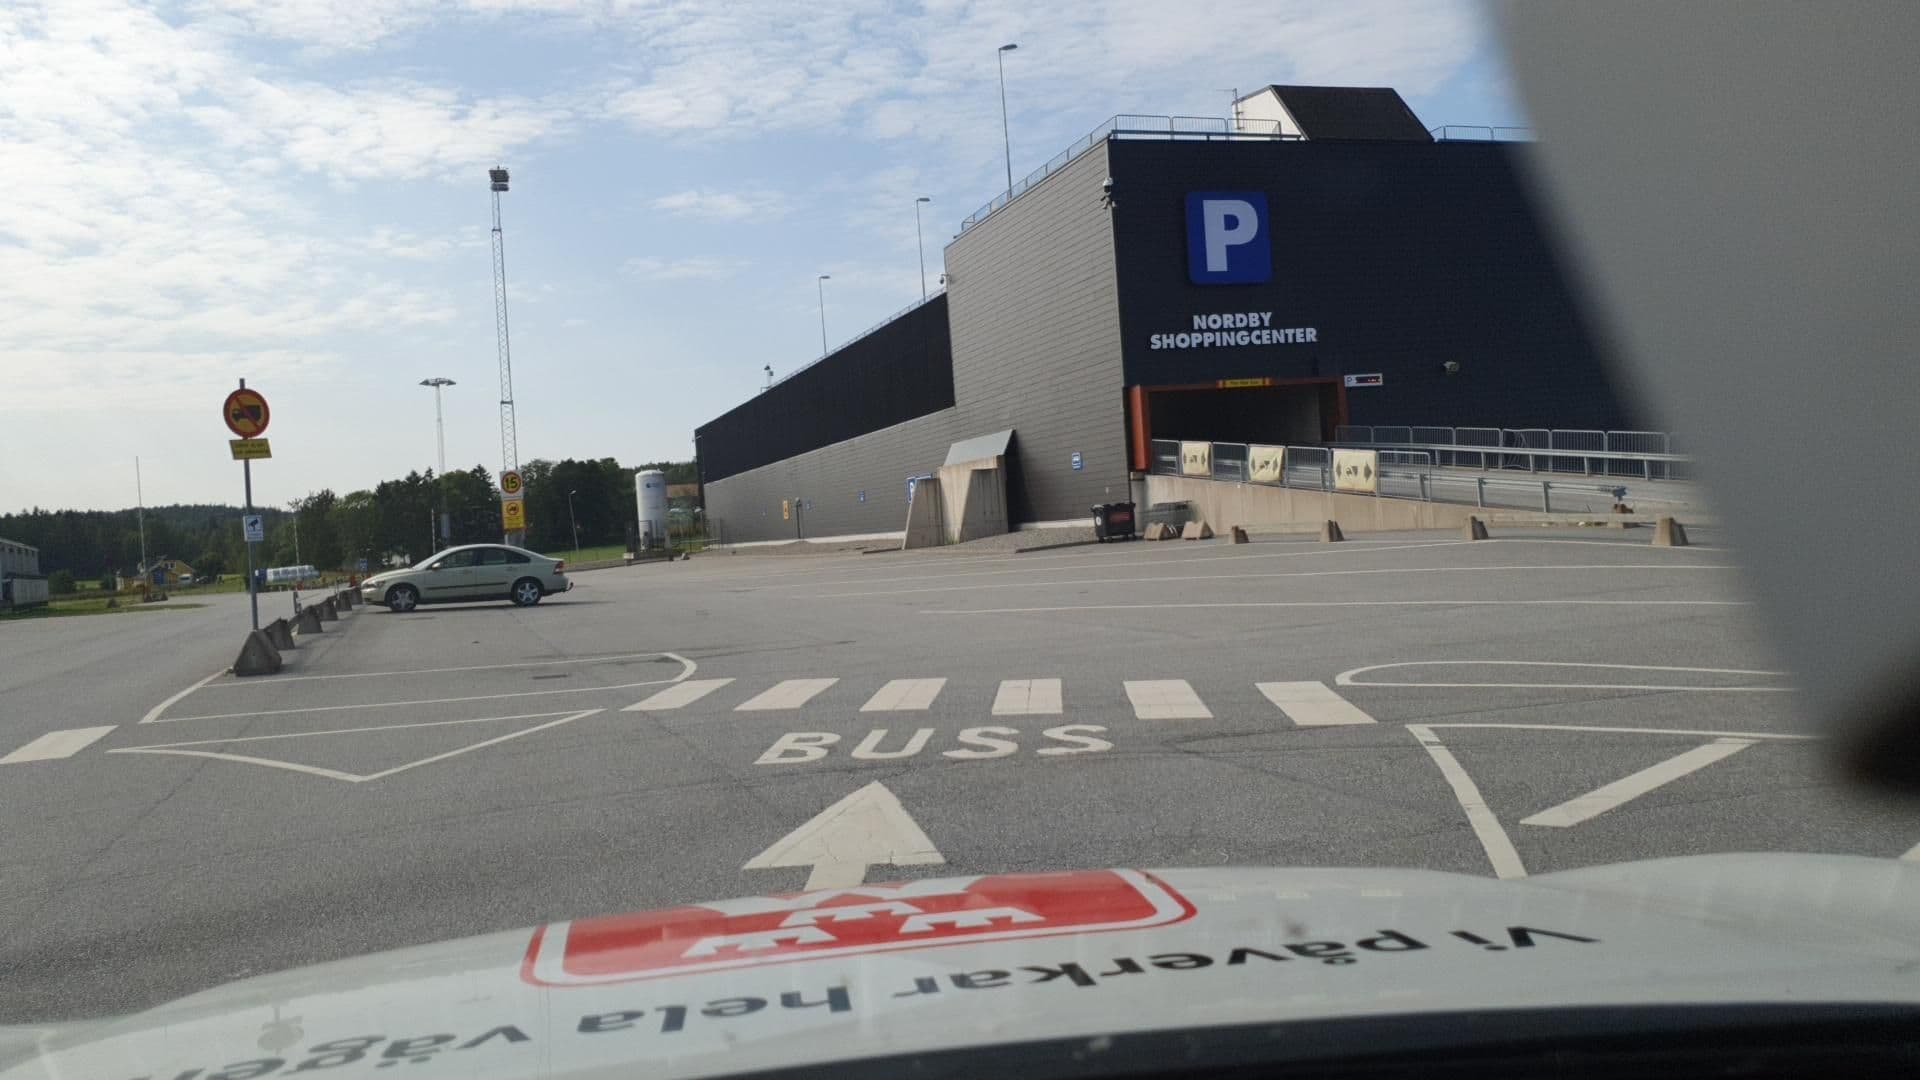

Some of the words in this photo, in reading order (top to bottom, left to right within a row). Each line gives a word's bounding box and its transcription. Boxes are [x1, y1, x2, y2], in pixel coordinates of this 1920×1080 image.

[1203, 199, 1258, 272] P
[1150, 328, 1317, 349] SHOPPINGCENTER
[1192, 312, 1272, 330] NORDBY
[505, 476, 518, 489] 15
[752, 724, 1114, 765] BUSS
[1450, 926, 1602, 952] Vi
[892, 929, 1430, 999] påverkar
[577, 986, 851, 1033] hela
[129, 1025, 531, 1080] väge
